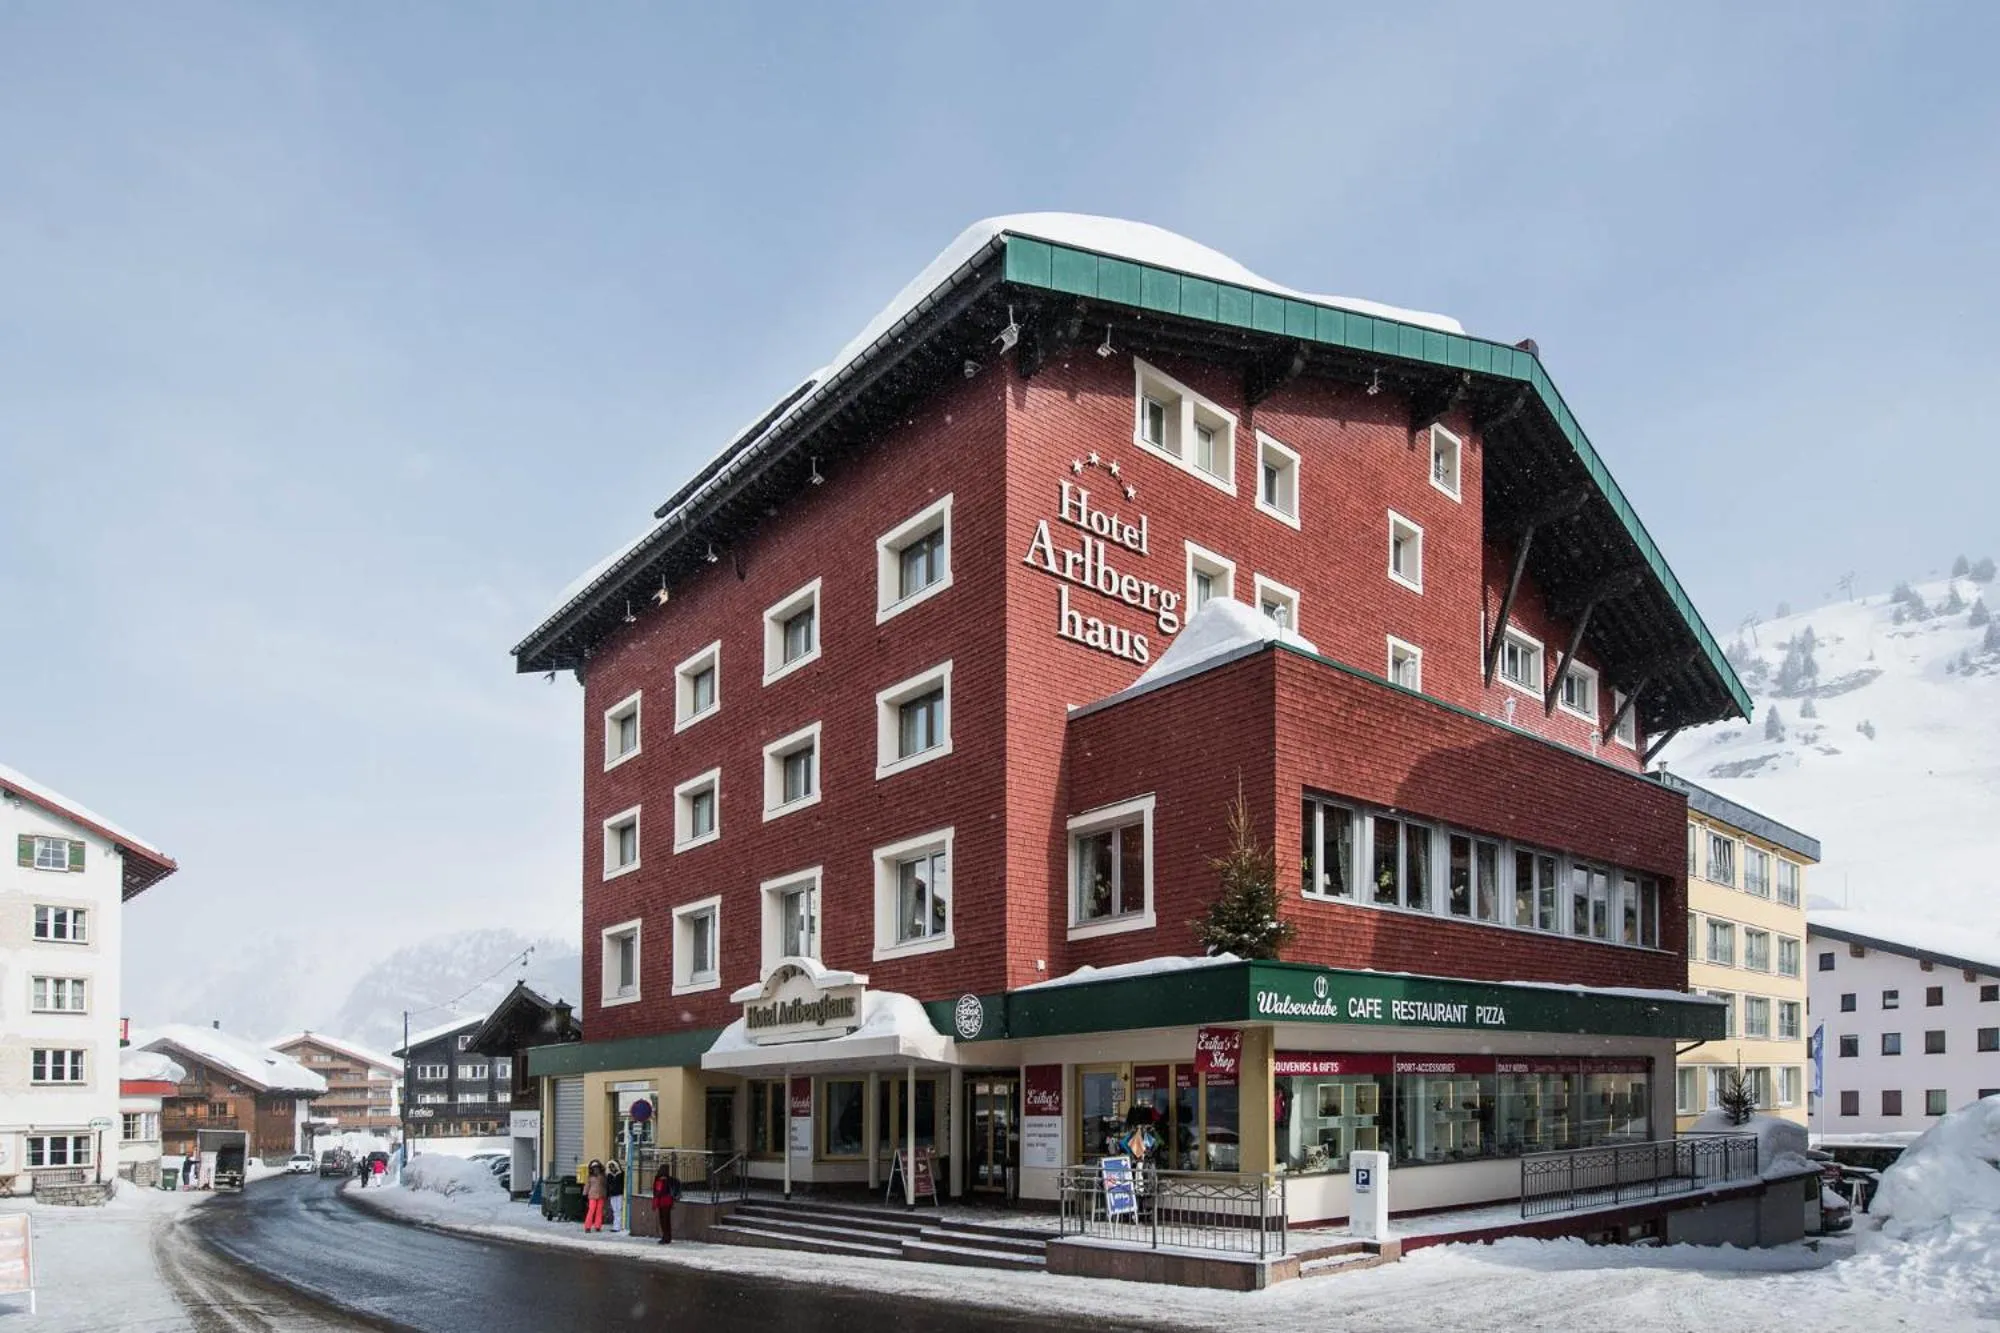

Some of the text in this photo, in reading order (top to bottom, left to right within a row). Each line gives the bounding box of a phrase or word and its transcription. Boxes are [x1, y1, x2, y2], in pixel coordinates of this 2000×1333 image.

[1058, 479, 1150, 555] Hotel
[1023, 519, 1182, 634] Arlberg
[1057, 584, 1150, 664] haus
[746, 994, 856, 1029] Hotel Arlberghaus
[1256, 990, 1506, 1025] Walserstube CAFE RESTAURANT PIZZA
[1198, 1032, 1231, 1051] Erika's
[1209, 1051, 1236, 1073] Shop
[1319, 1061, 1340, 1073] GIFTS
[1396, 1062, 1456, 1073] SPORT-ACCESSORIES
[1358, 1171, 1368, 1184] P
